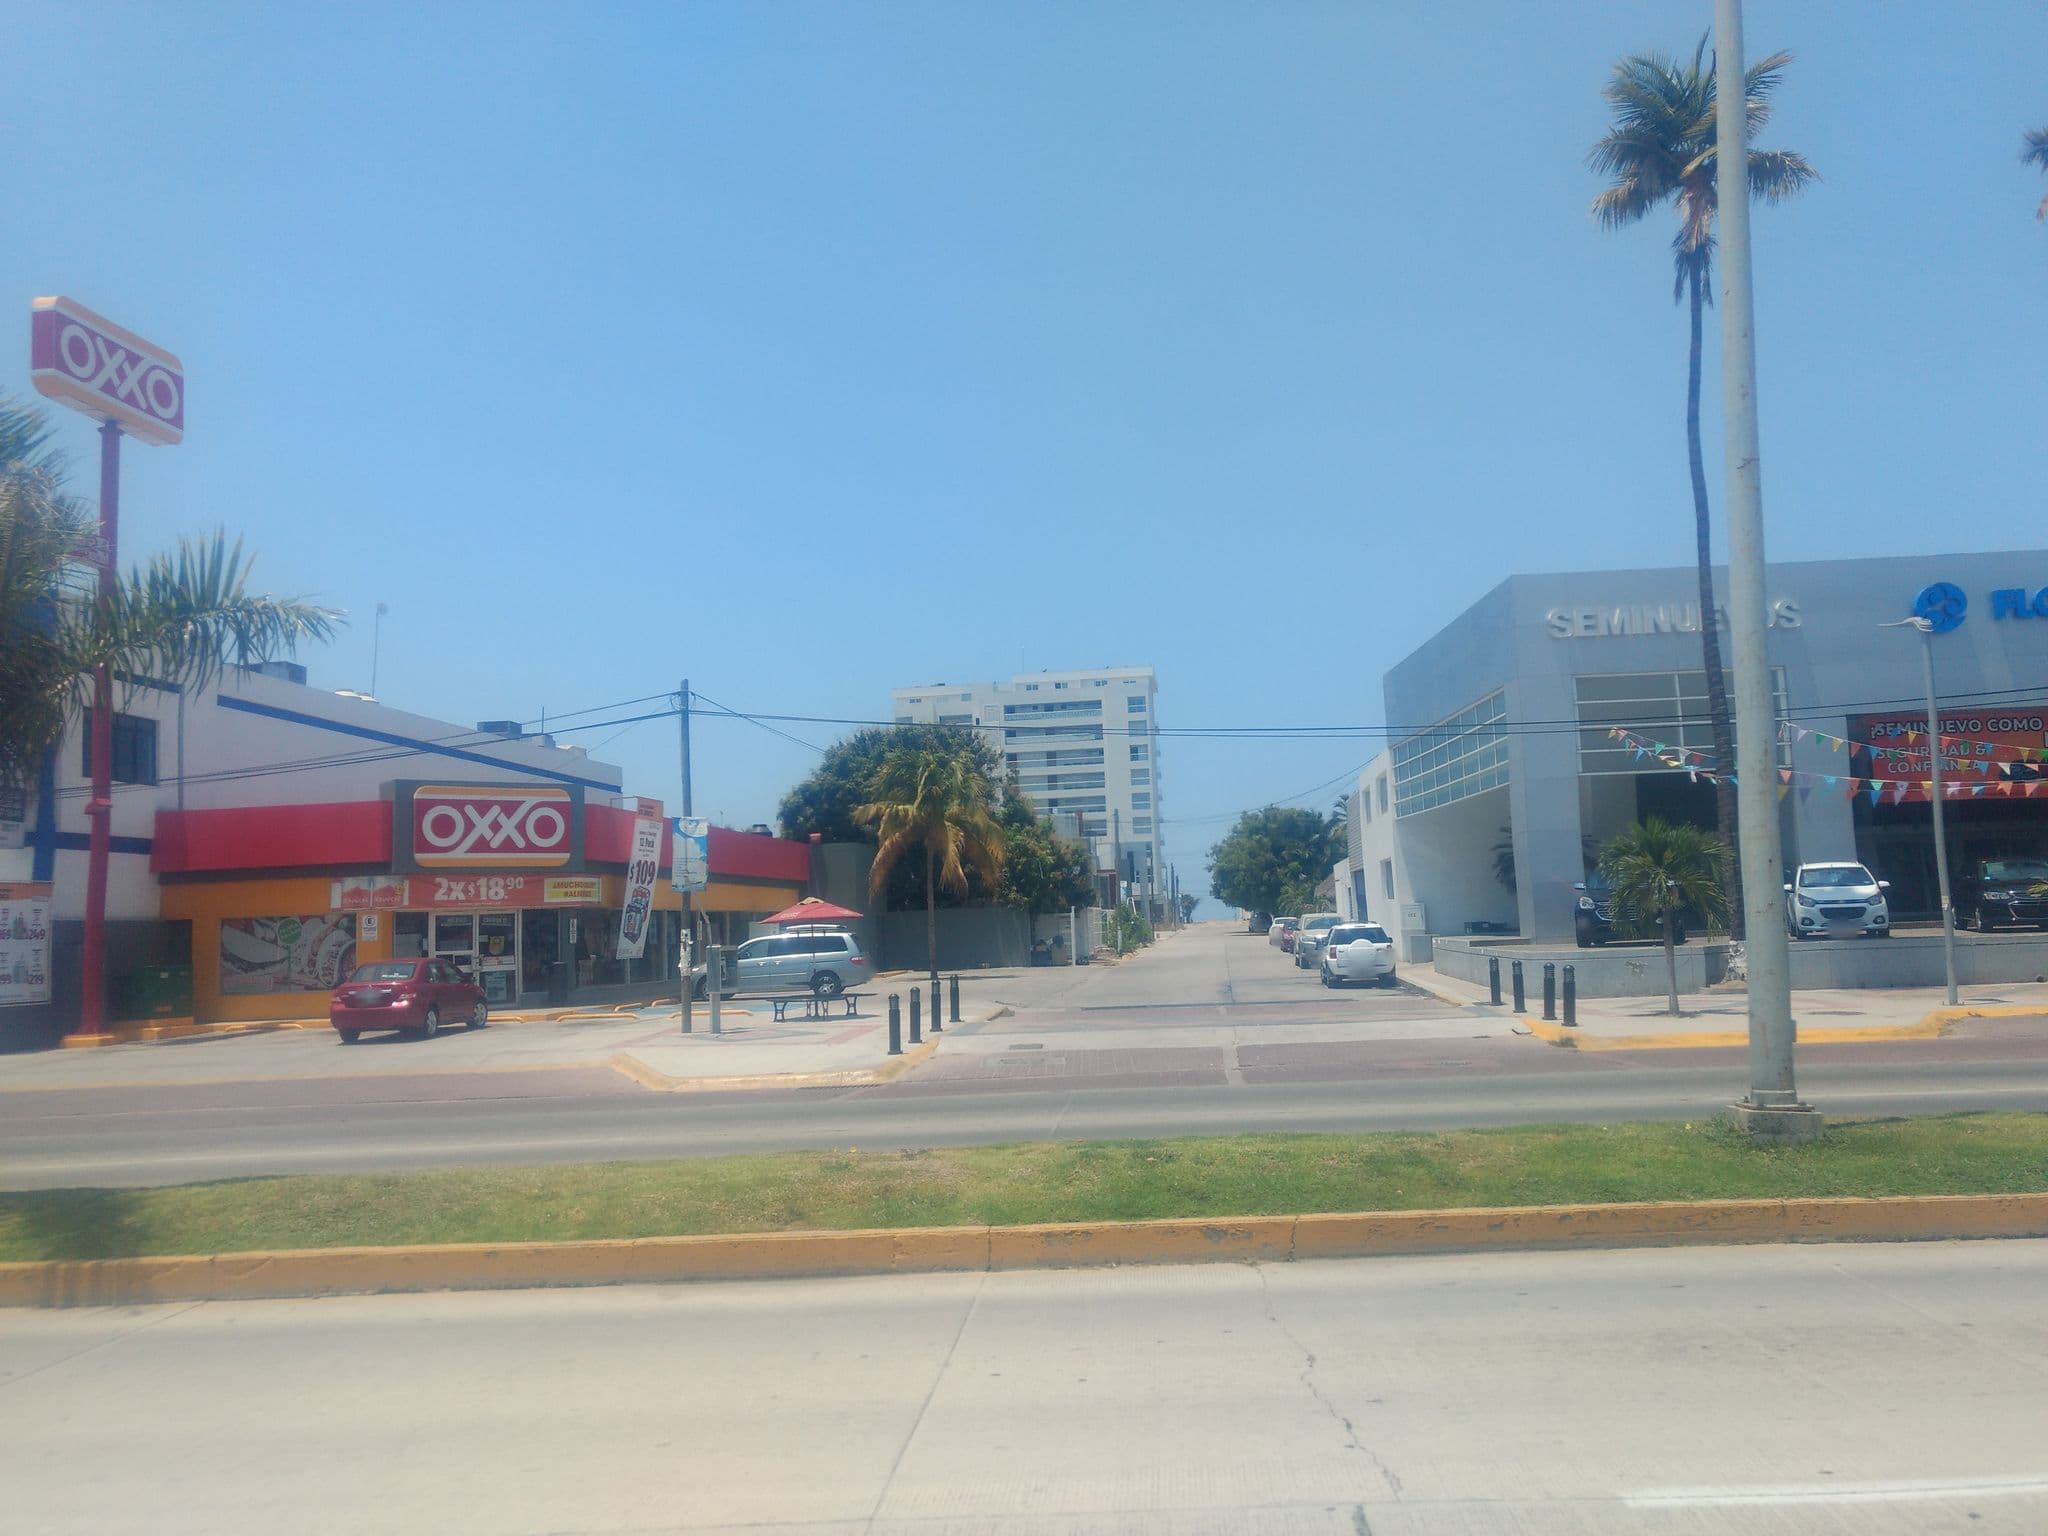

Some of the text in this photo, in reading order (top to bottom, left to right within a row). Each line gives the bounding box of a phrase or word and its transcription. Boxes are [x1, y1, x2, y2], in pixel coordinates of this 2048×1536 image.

[60, 323, 181, 420] OXXO
[1545, 598, 1802, 638] SEMINUS
[1987, 716, 2044, 732] COMO
[422, 803, 565, 853] OXXO
